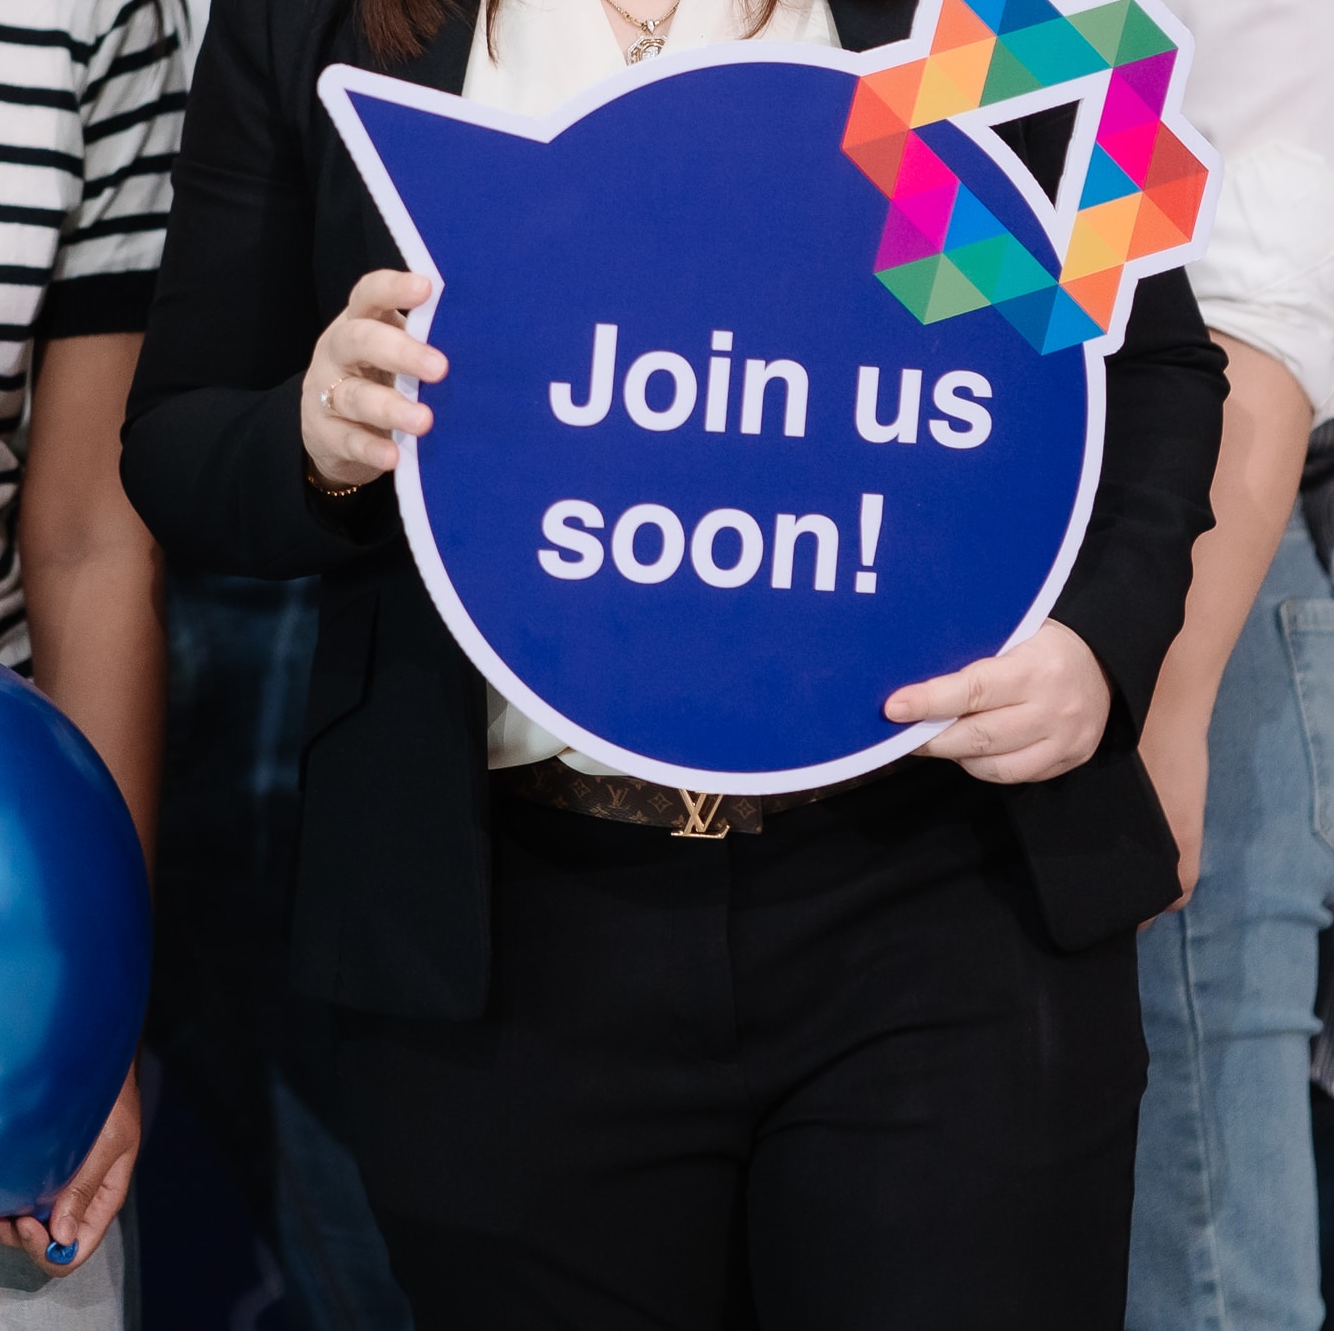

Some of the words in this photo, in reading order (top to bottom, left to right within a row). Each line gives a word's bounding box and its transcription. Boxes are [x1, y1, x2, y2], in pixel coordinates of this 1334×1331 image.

[548, 322, 811, 439] Join
[854, 364, 995, 450] us
[537, 492, 885, 595] soon!
